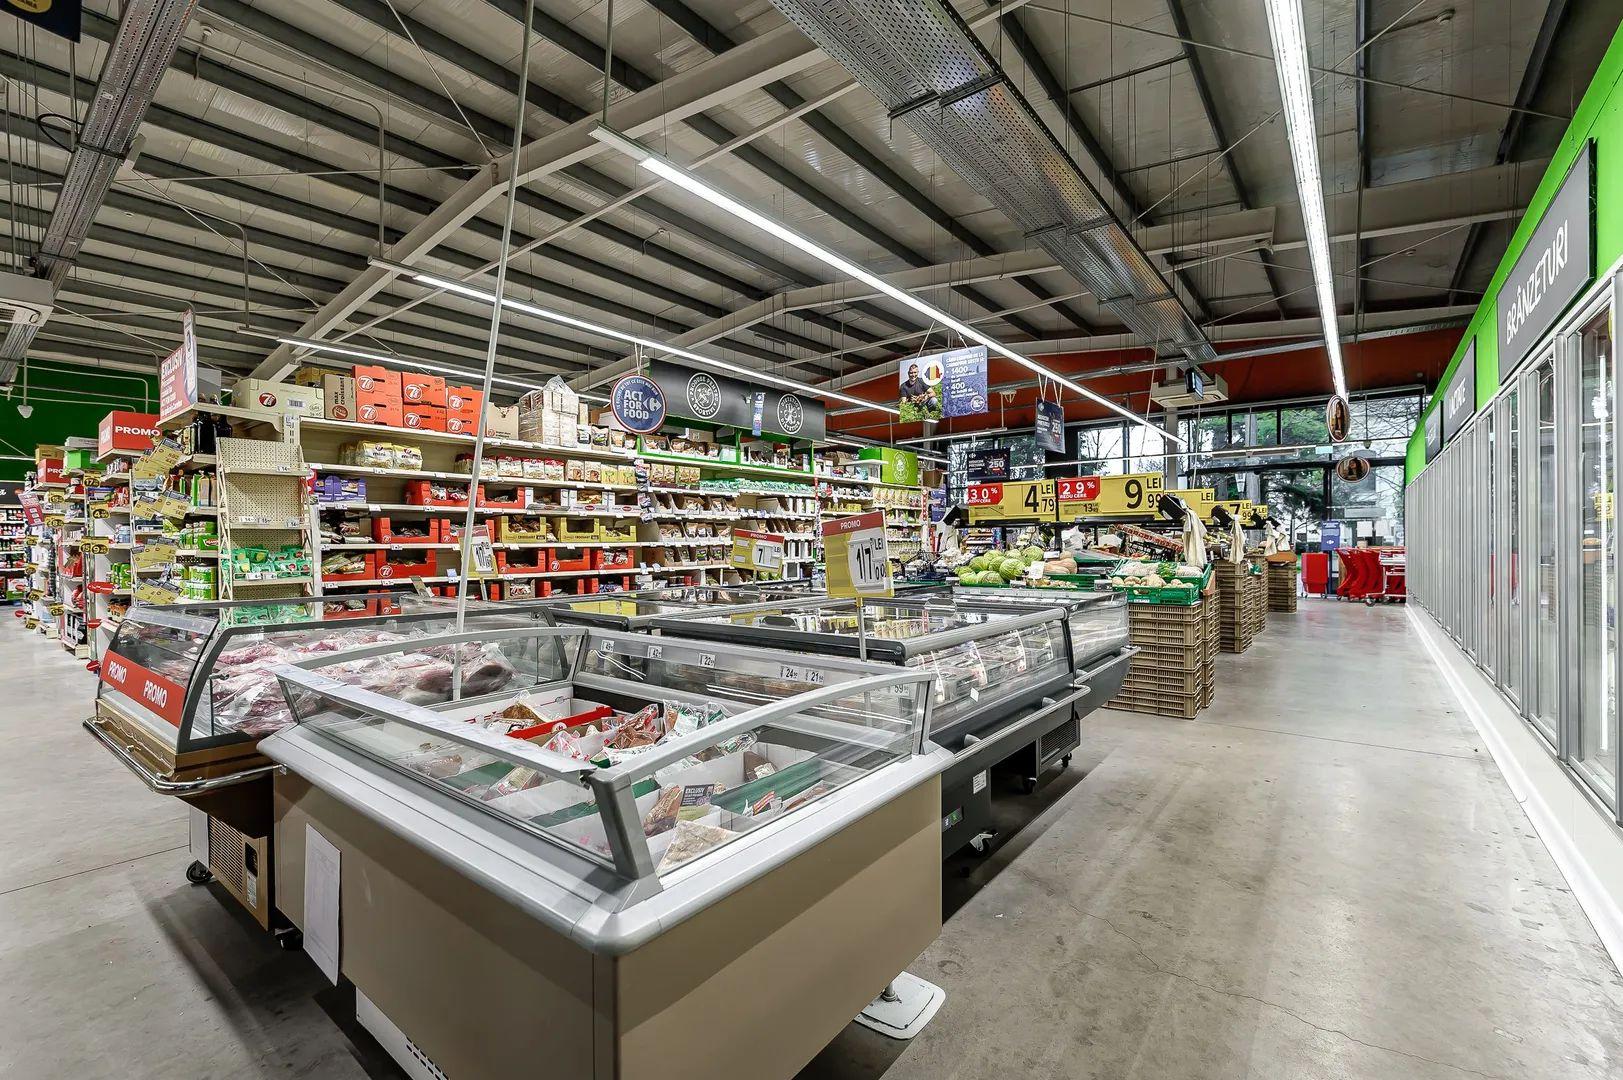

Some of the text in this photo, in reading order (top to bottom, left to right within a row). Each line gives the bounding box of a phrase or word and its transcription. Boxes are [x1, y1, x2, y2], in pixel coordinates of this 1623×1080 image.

[1506, 219, 1568, 345] BRÂNZETURI
[951, 366, 969, 374] 1400
[951, 382, 966, 390] 400
[624, 390, 643, 401] ACT
[624, 400, 643, 410] FOR
[624, 409, 649, 420] FOOD
[115, 425, 160, 437] PROMO
[988, 460, 1004, 469] 250
[1146, 478, 1161, 489] LEI
[1041, 484, 1054, 495] LEI
[1125, 479, 1143, 509] 9
[1024, 485, 1040, 513] 4
[1147, 493, 1161, 509] 99
[1201, 492, 1214, 501] LEI
[1042, 498, 1055, 512] 79
[1083, 503, 1093, 513] 13
[840, 519, 861, 530] PROMO
[758, 548, 763, 563] 7
[107, 660, 127, 684] PROMO
[143, 679, 168, 709] PROMO
